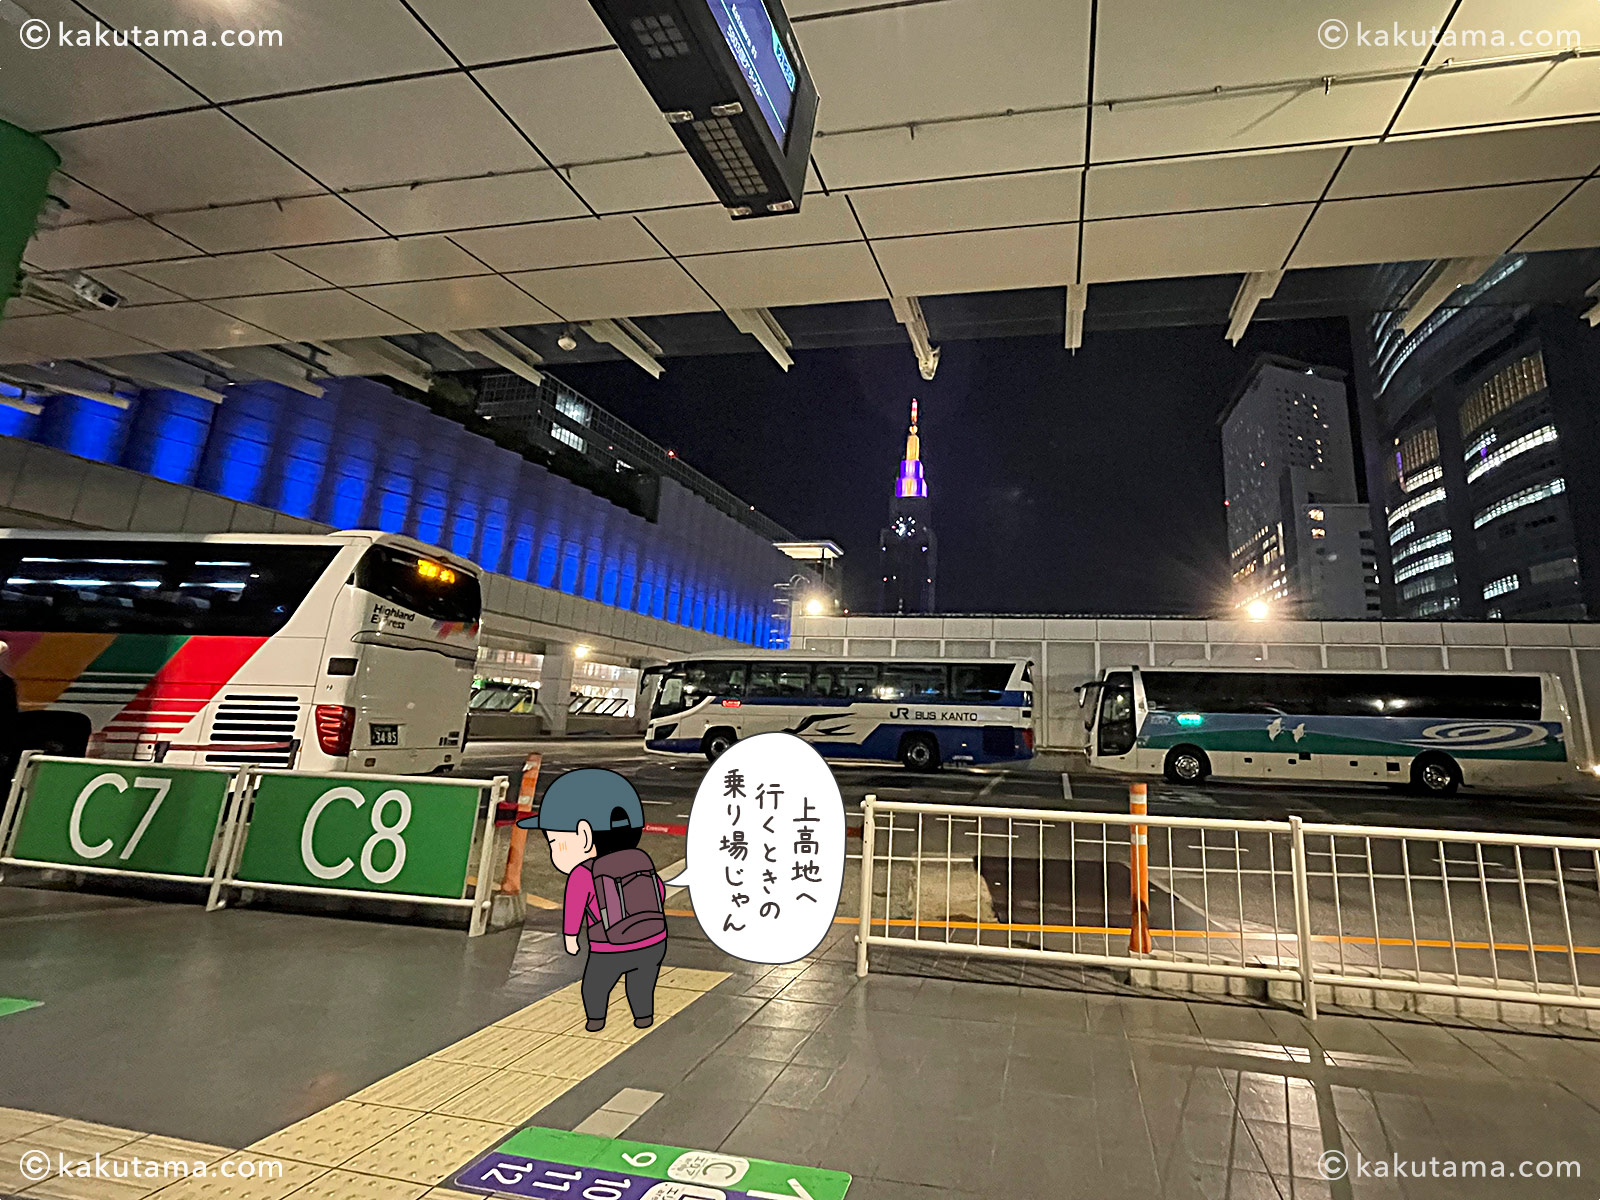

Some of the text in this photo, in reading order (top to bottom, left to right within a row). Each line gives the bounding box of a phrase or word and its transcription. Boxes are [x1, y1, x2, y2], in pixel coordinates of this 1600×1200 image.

[373, 604, 416, 622] Highland
[890, 708, 978, 722] JR BUS KANTO
[69, 772, 172, 860] C7
[301, 786, 412, 884] C8
[480, 1162, 533, 1185] 12
[532, 1171, 582, 1191] 11
[702, 1162, 737, 1180] C
[582, 1178, 631, 1200] 10
